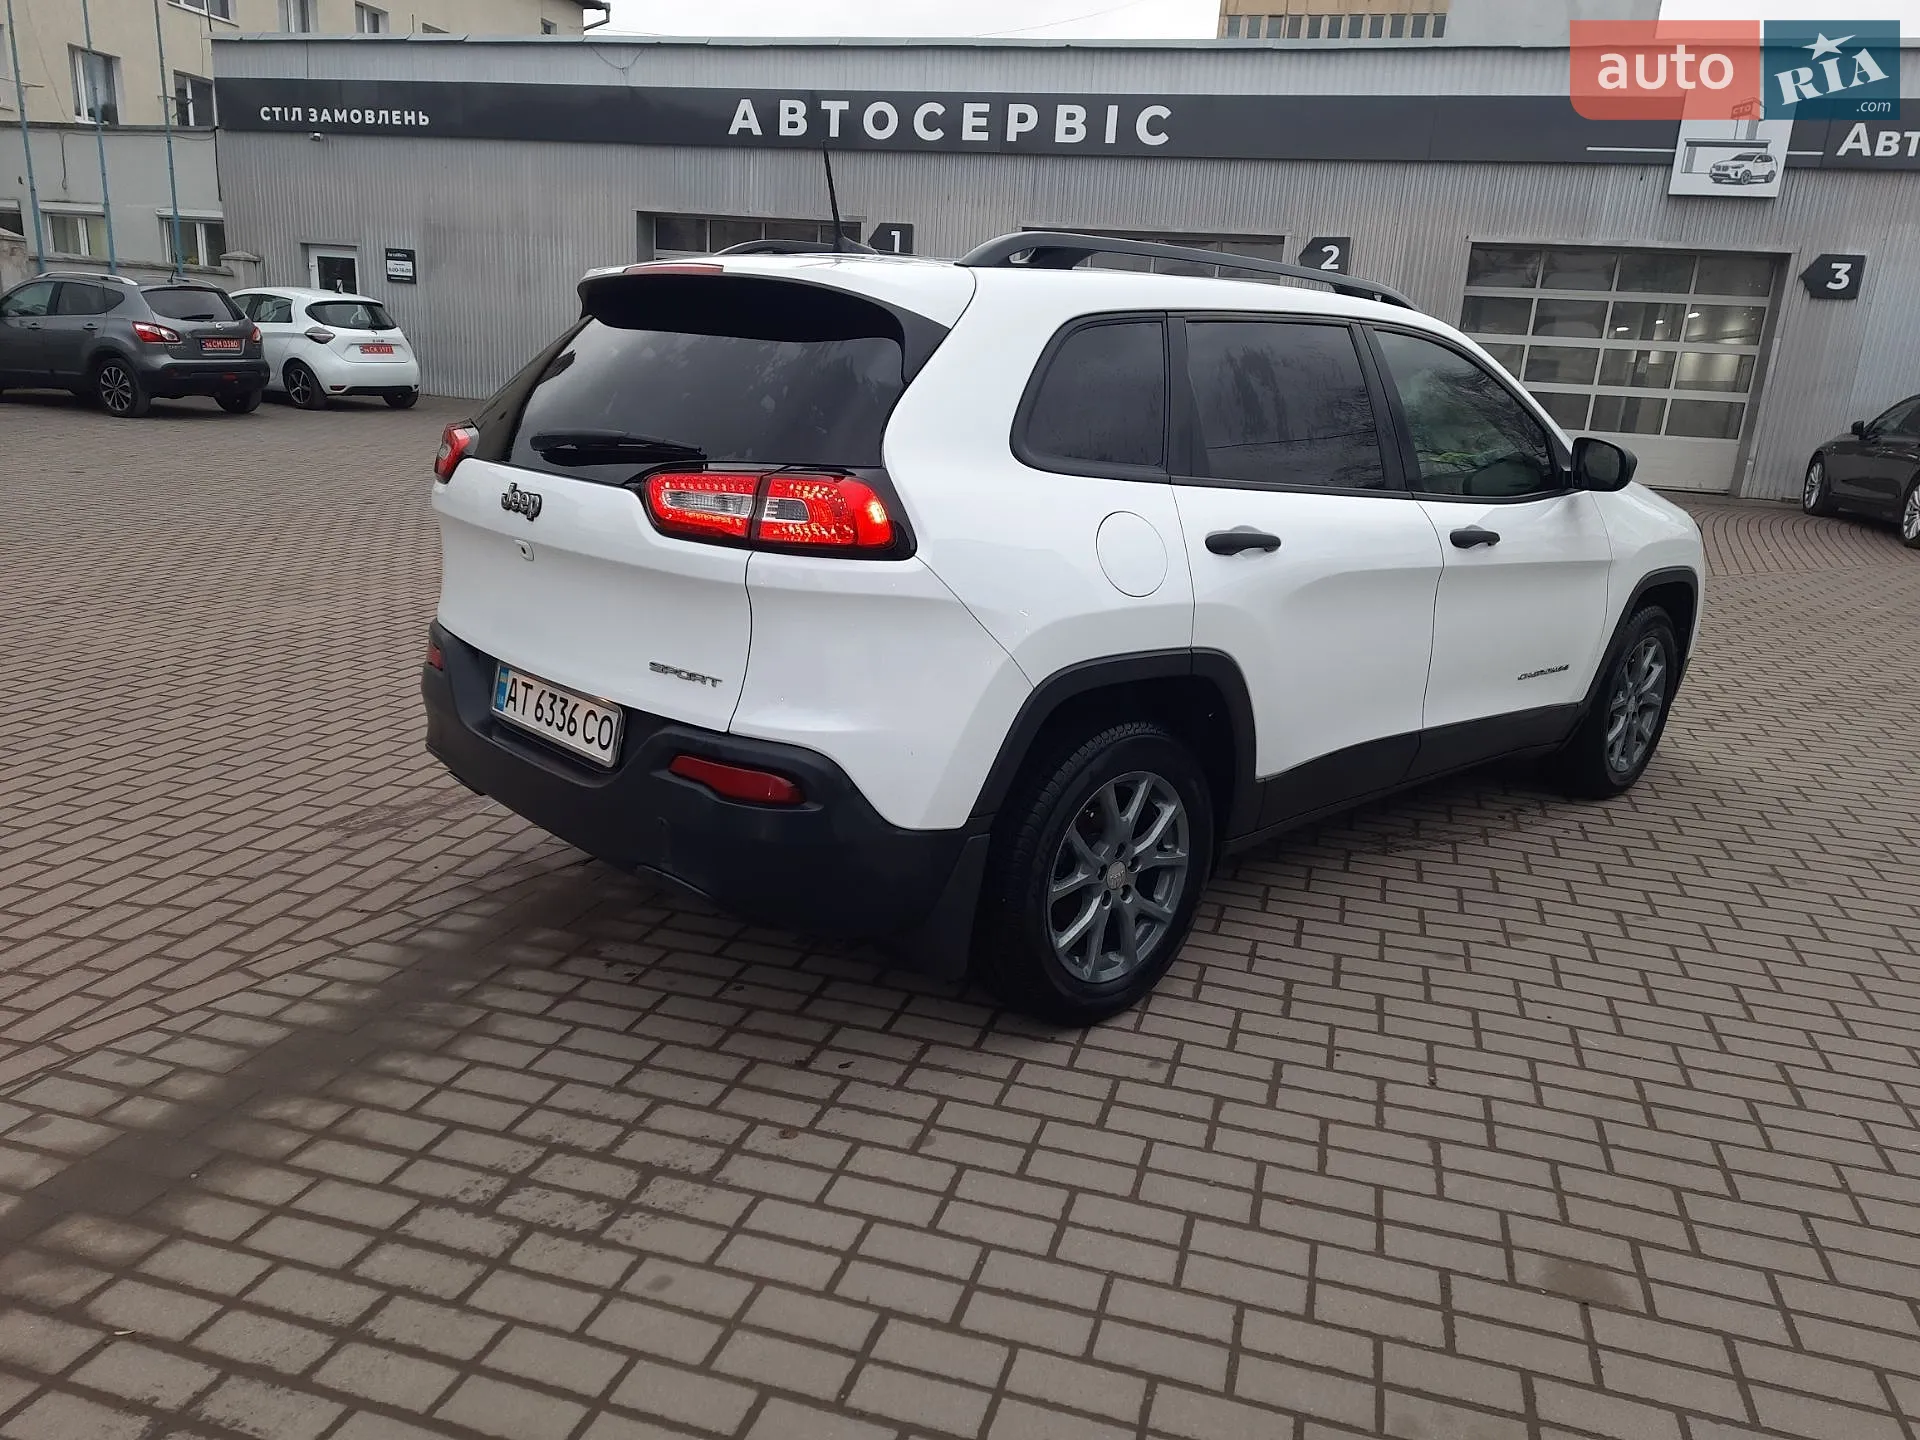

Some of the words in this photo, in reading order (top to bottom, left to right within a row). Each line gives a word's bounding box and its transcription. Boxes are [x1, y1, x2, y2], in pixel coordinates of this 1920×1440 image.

[260, 106, 303, 121] СТІЛ
[308, 107, 430, 126] ЗАМОВЛЕНЬ
[727, 98, 1172, 146] АВТОСЕРВІС
[890, 230, 901, 253] 1
[1320, 244, 1340, 270] 2
[1826, 262, 1852, 290] 3
[501, 482, 543, 522] Jeep
[648, 661, 723, 688] SPORT
[505, 677, 534, 716] AT
[534, 689, 580, 737] 6336
[582, 709, 614, 751] CO
